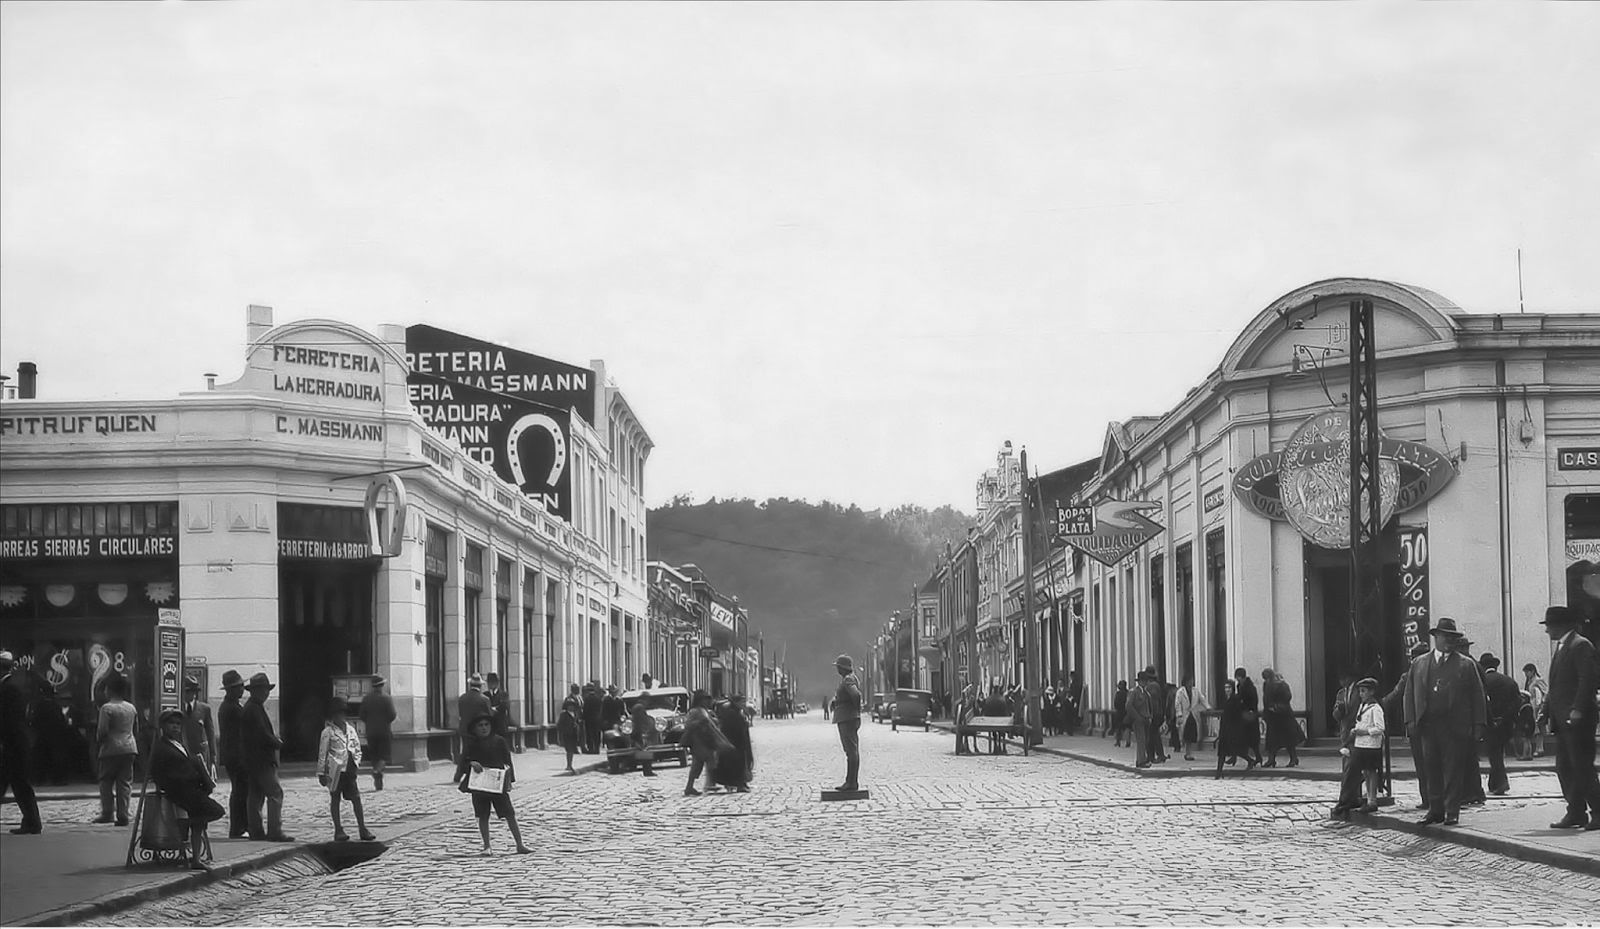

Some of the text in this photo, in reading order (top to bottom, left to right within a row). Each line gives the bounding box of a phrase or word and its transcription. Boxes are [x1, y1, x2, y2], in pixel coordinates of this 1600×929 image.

[274, 346, 380, 373] FERRETERIA
[274, 374, 381, 402] LA HERRADURA
[0, 415, 156, 436] PITRUFQUEN
[277, 416, 383, 442] C. MASSMANN
[426, 425, 489, 444] MANN
[463, 446, 495, 465] CO
[1564, 452, 1598, 466] CAS
[1058, 508, 1092, 522] BODAS
[1058, 522, 1091, 534] PLATA
[44, 539, 91, 557] SIERRAS
[99, 537, 174, 556] CIRCULARES
[1400, 533, 1427, 569] 50
[1403, 573, 1424, 601] %
